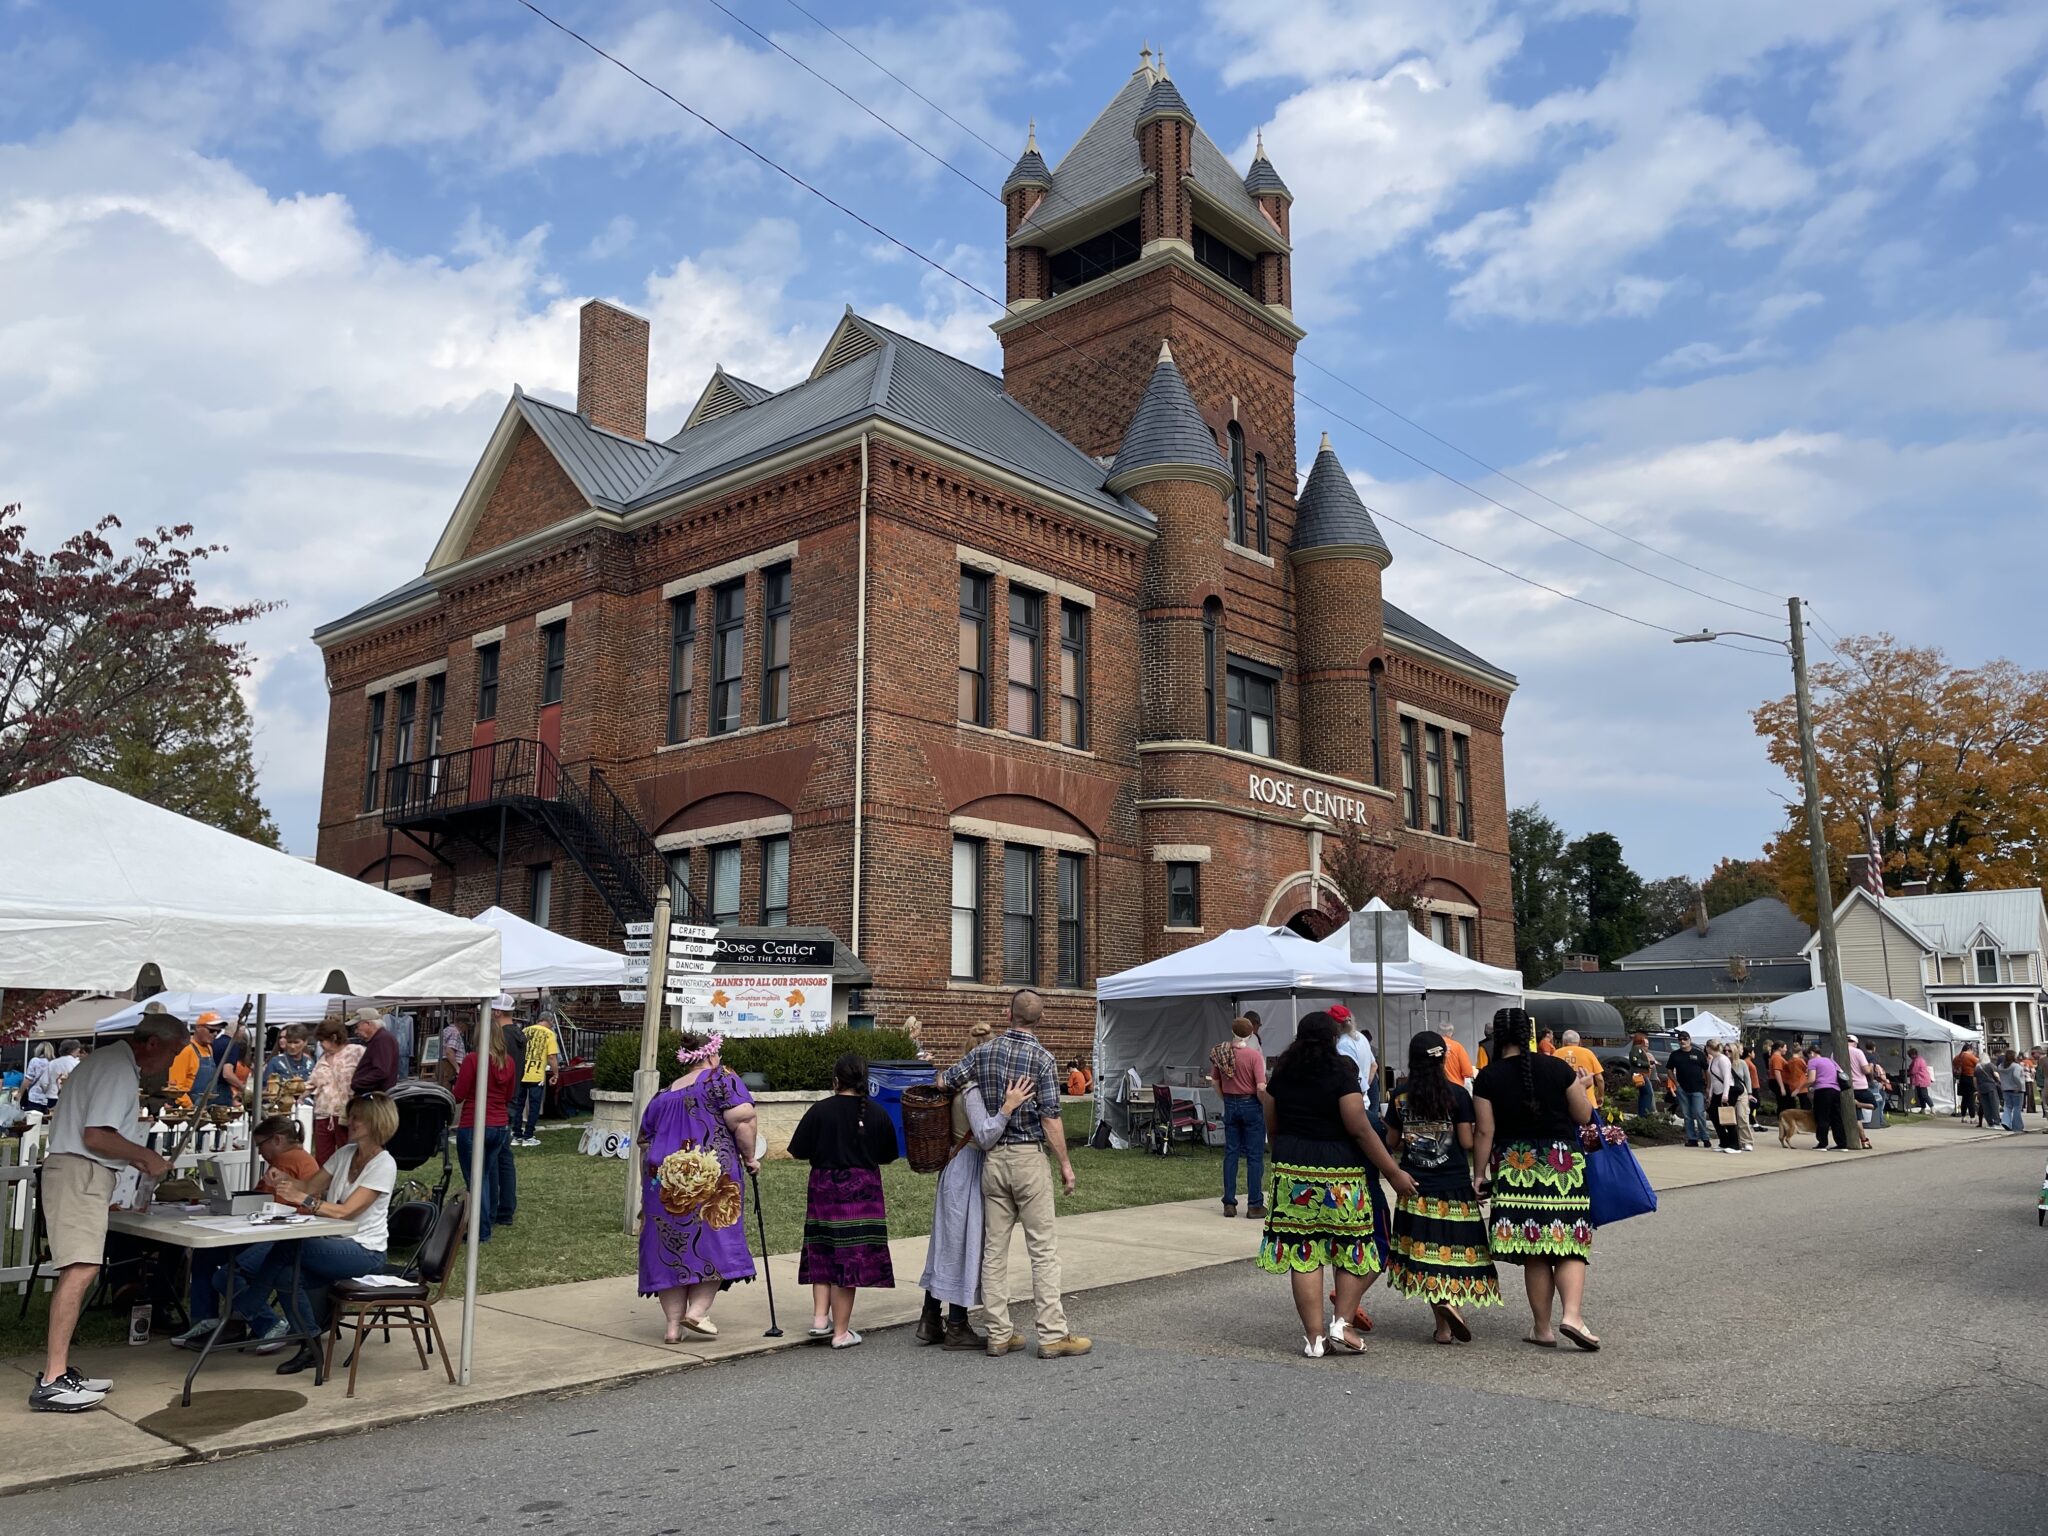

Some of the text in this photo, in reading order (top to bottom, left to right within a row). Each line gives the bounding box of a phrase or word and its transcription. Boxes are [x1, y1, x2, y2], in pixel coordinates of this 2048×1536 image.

[1249, 774, 1369, 826] ROSE CENTER
[631, 924, 650, 932] CRAFTS
[678, 926, 706, 937] CRAFTS
[626, 941, 651, 950] FOOD MUSIC
[685, 944, 704, 953] FOOD
[714, 939, 816, 956] Rose Center
[627, 958, 650, 966] DANCING
[757, 955, 772, 963] THE
[775, 956, 797, 964] ARTS
[675, 960, 705, 971] DANCING
[629, 976, 643, 984] GAMES
[744, 978, 755, 987] TO
[756, 978, 771, 987] ALL
[771, 977, 788, 987] OUR
[788, 977, 828, 987] SPONSORS
[675, 996, 696, 1005] MUSIC
[747, 1000, 769, 1010] festival
